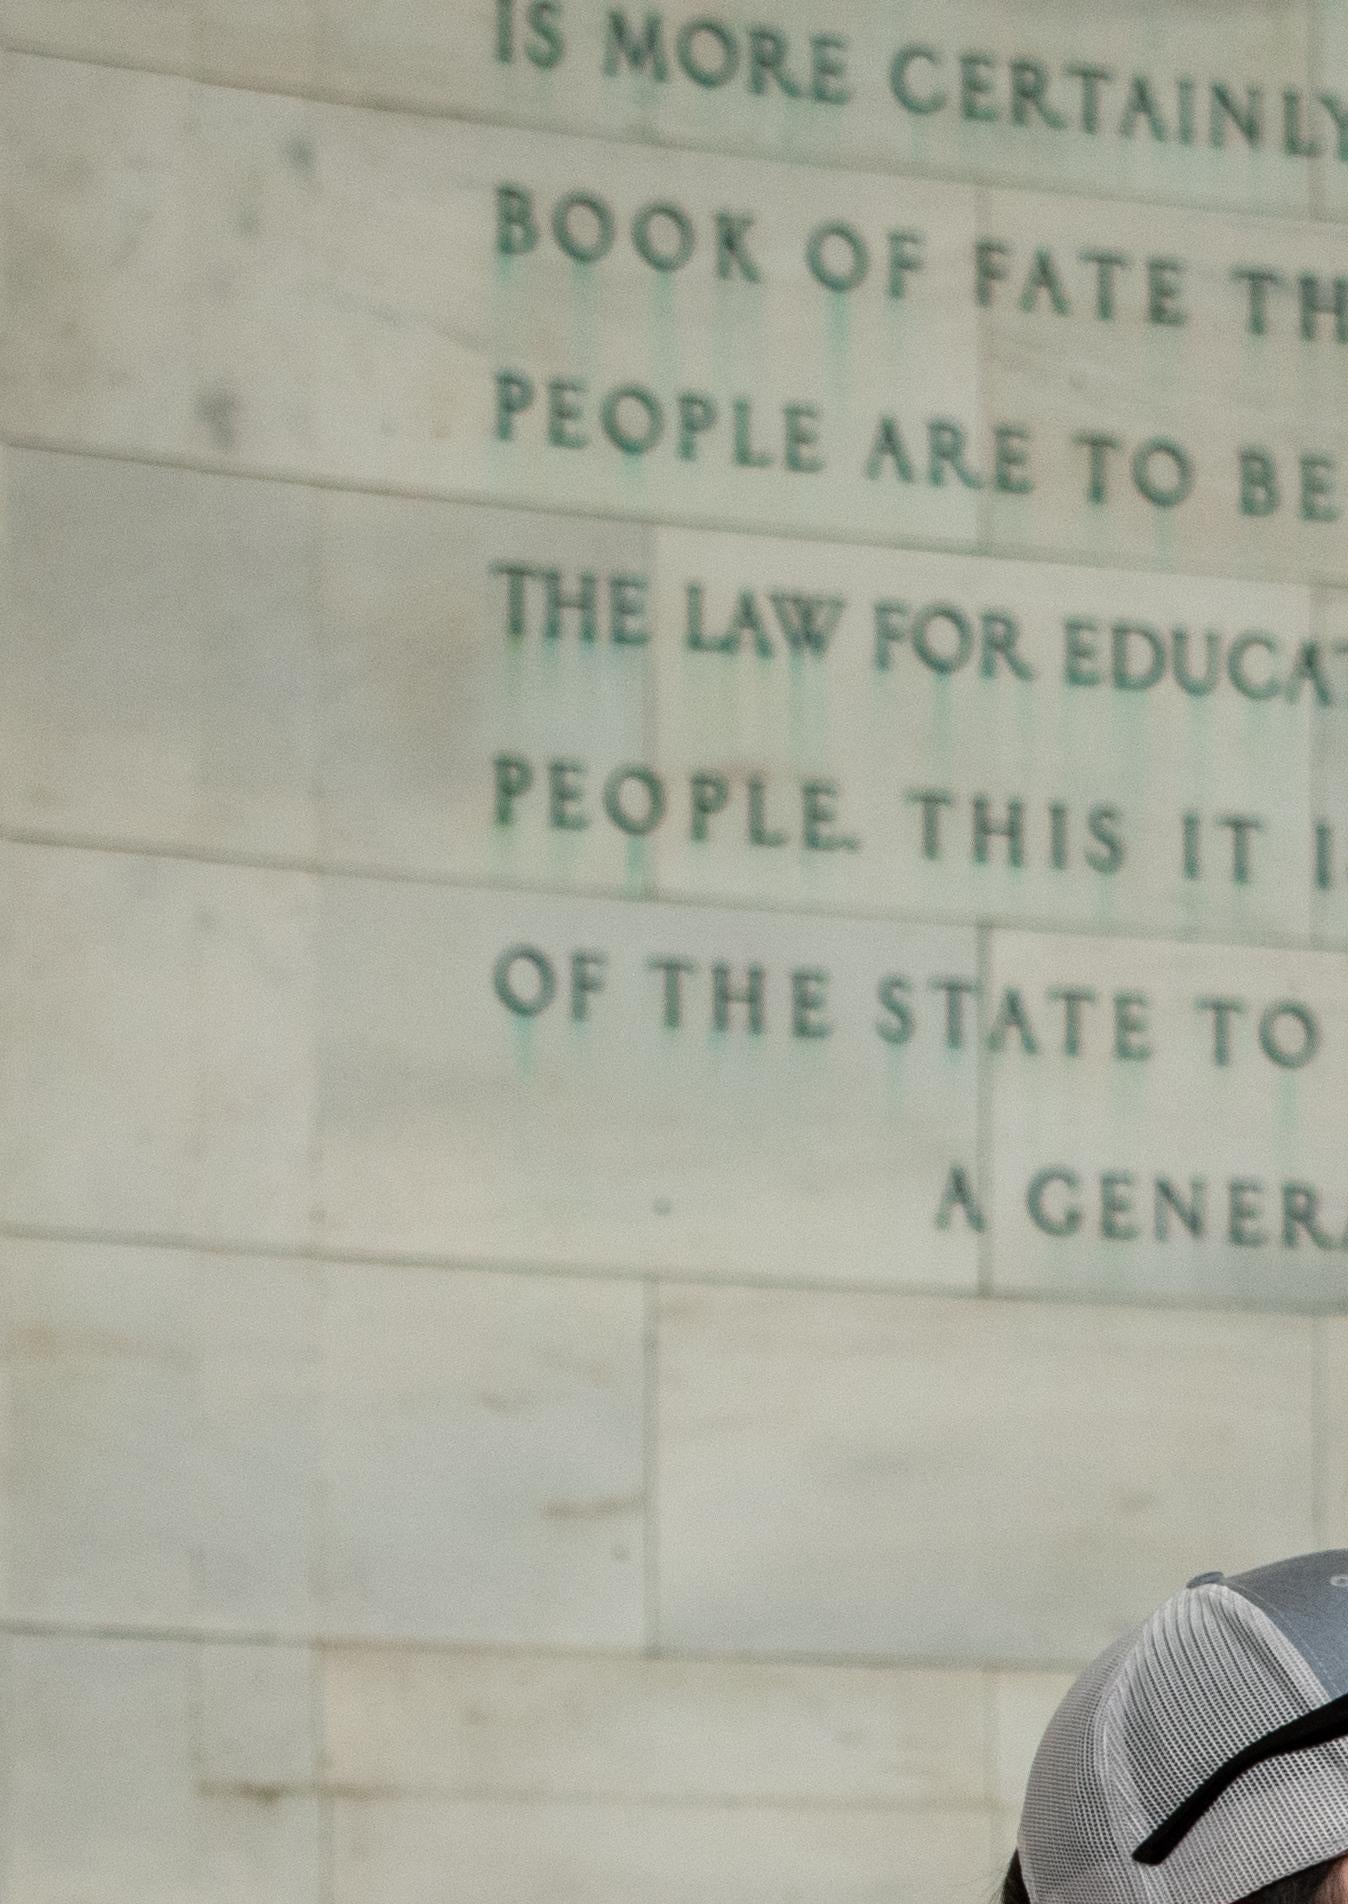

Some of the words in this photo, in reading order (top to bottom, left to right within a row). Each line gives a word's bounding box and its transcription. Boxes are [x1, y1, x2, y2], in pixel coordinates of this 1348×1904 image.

[493, 0, 563, 69] IS
[603, 10, 852, 106] MORE
[496, 183, 759, 285] BOOK
[807, 219, 925, 301] OF
[976, 240, 1187, 327] FATE
[496, 369, 824, 473] PEOPLE
[866, 416, 1035, 494] ARE
[1074, 432, 1195, 508] TO
[1239, 449, 1339, 522] BE
[491, 561, 649, 647] THE
[687, 582, 844, 660] LAW
[874, 601, 1035, 681] FOR
[494, 751, 860, 851] PEOPLE.
[906, 786, 1126, 873] THIS
[1183, 811, 1266, 885] IT
[494, 945, 605, 1020] OF
[648, 957, 833, 1042] THE
[877, 974, 1153, 1062] STATE
[1199, 997, 1322, 1070] TO
[935, 1163, 988, 1233] A
